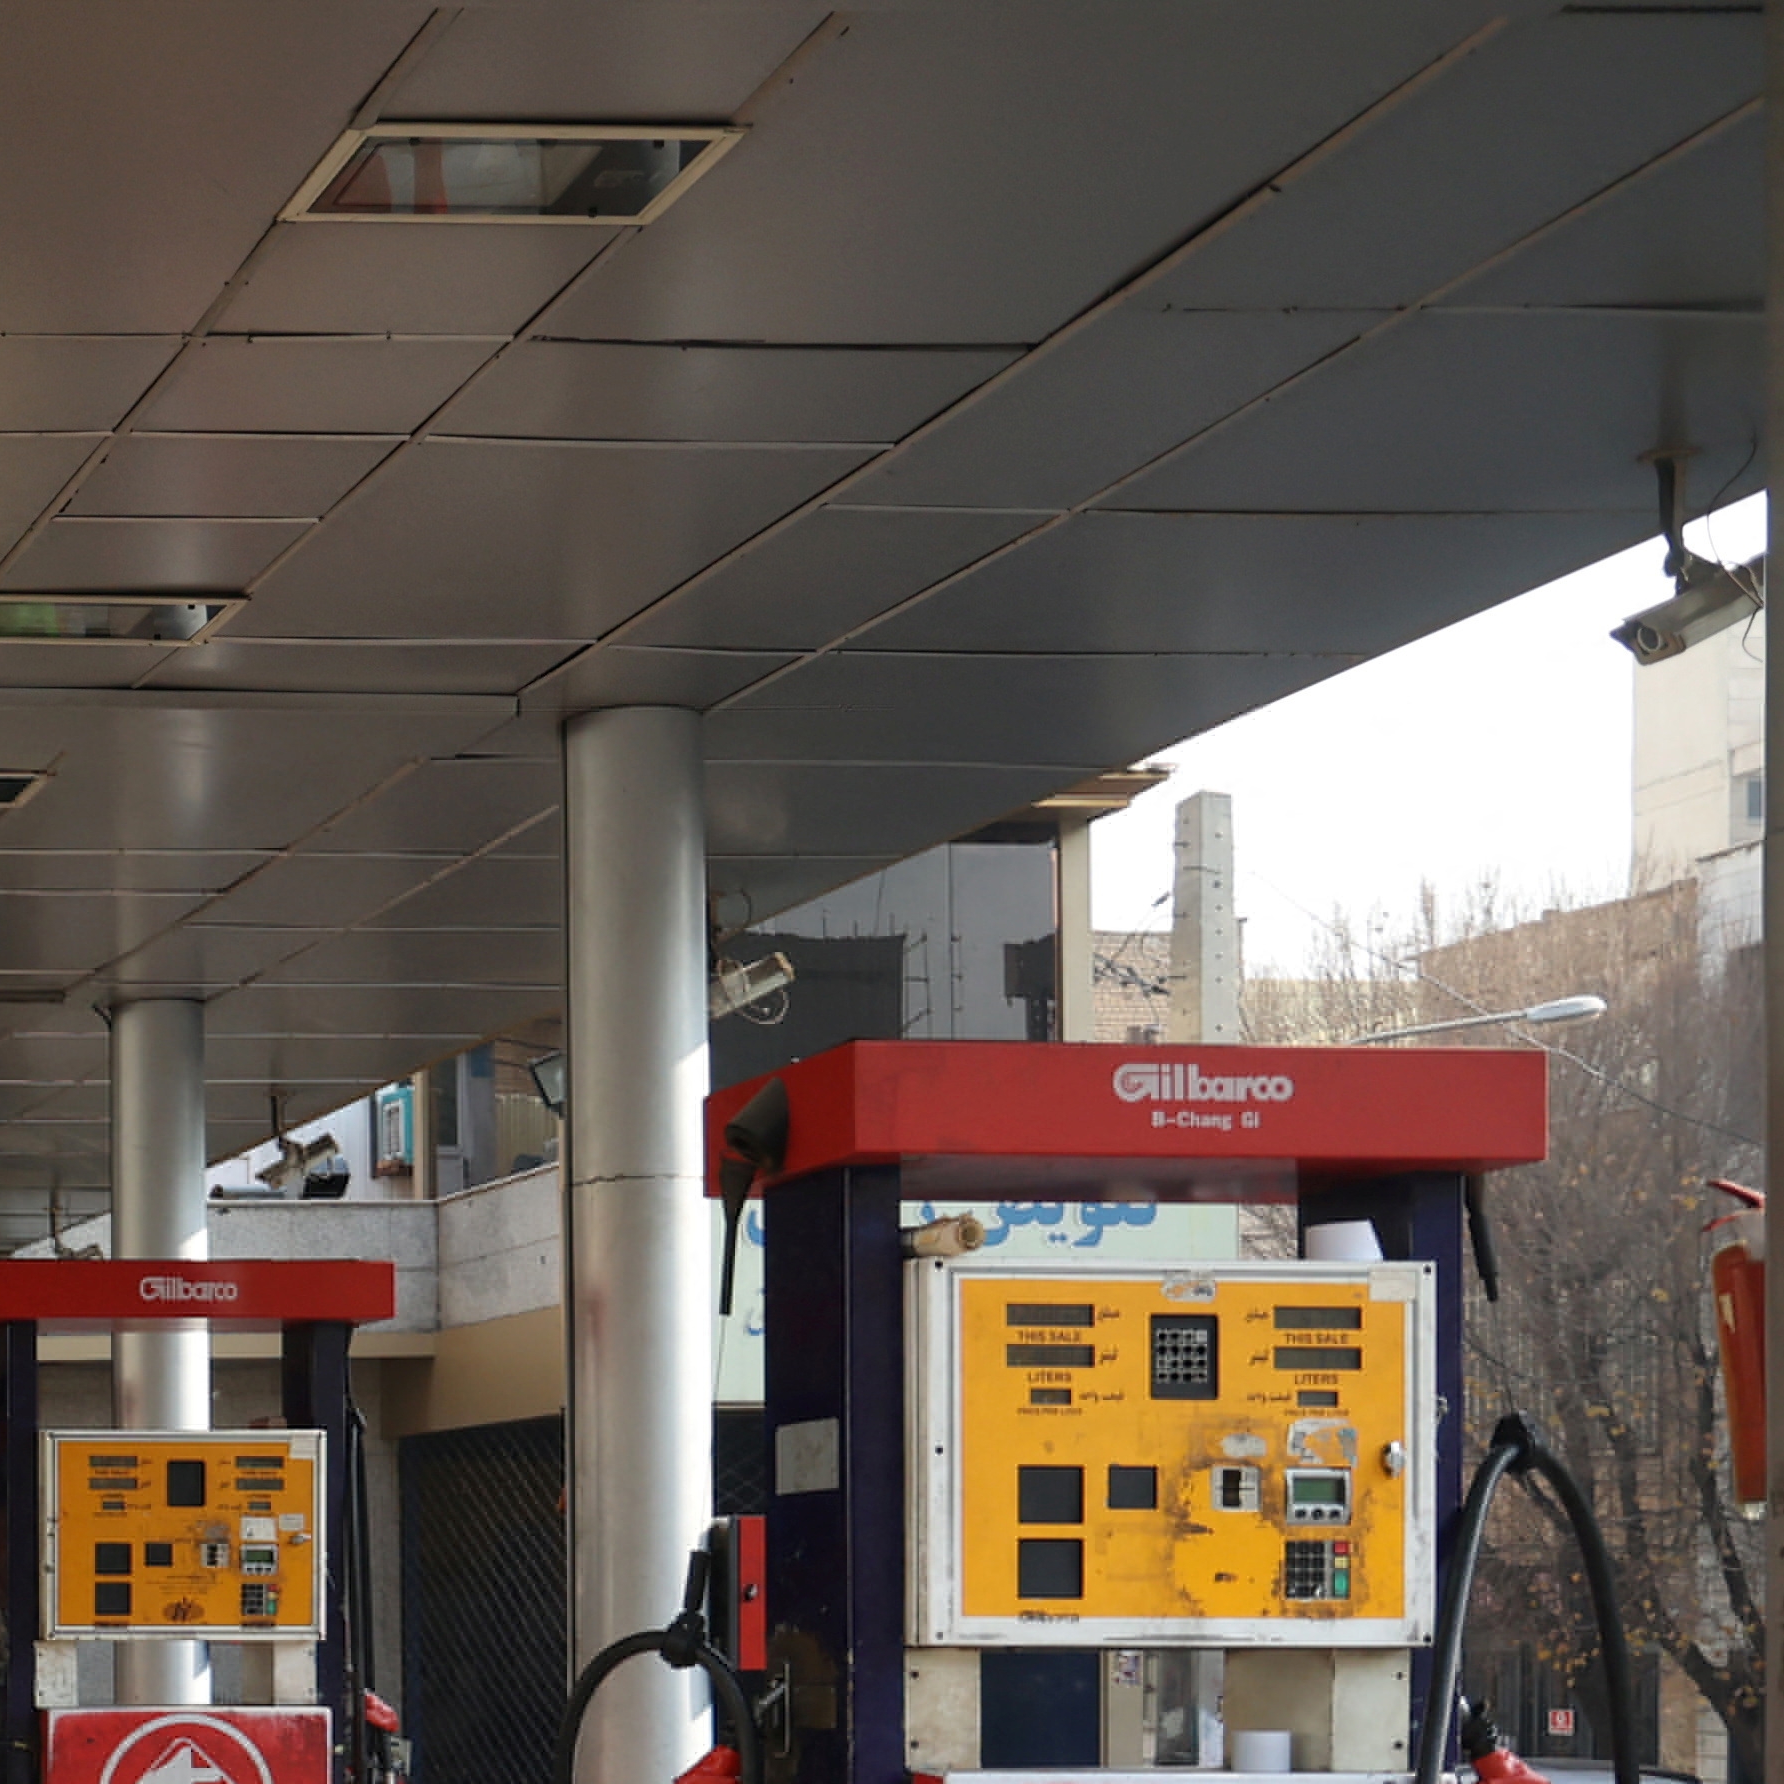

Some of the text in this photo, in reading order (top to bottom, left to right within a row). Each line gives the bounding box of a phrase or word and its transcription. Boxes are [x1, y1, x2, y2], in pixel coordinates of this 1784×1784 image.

[1113, 1063, 1295, 1102] Gilbarco
[1151, 1111, 1233, 1131] B-Chang
[140, 1276, 238, 1302] Gilbarco
[1017, 1330, 1081, 1342] THIS SALE
[1284, 1333, 1349, 1345] THIS SALE
[1027, 1372, 1072, 1384] LITERS
[1294, 1374, 1338, 1385] LITERS
